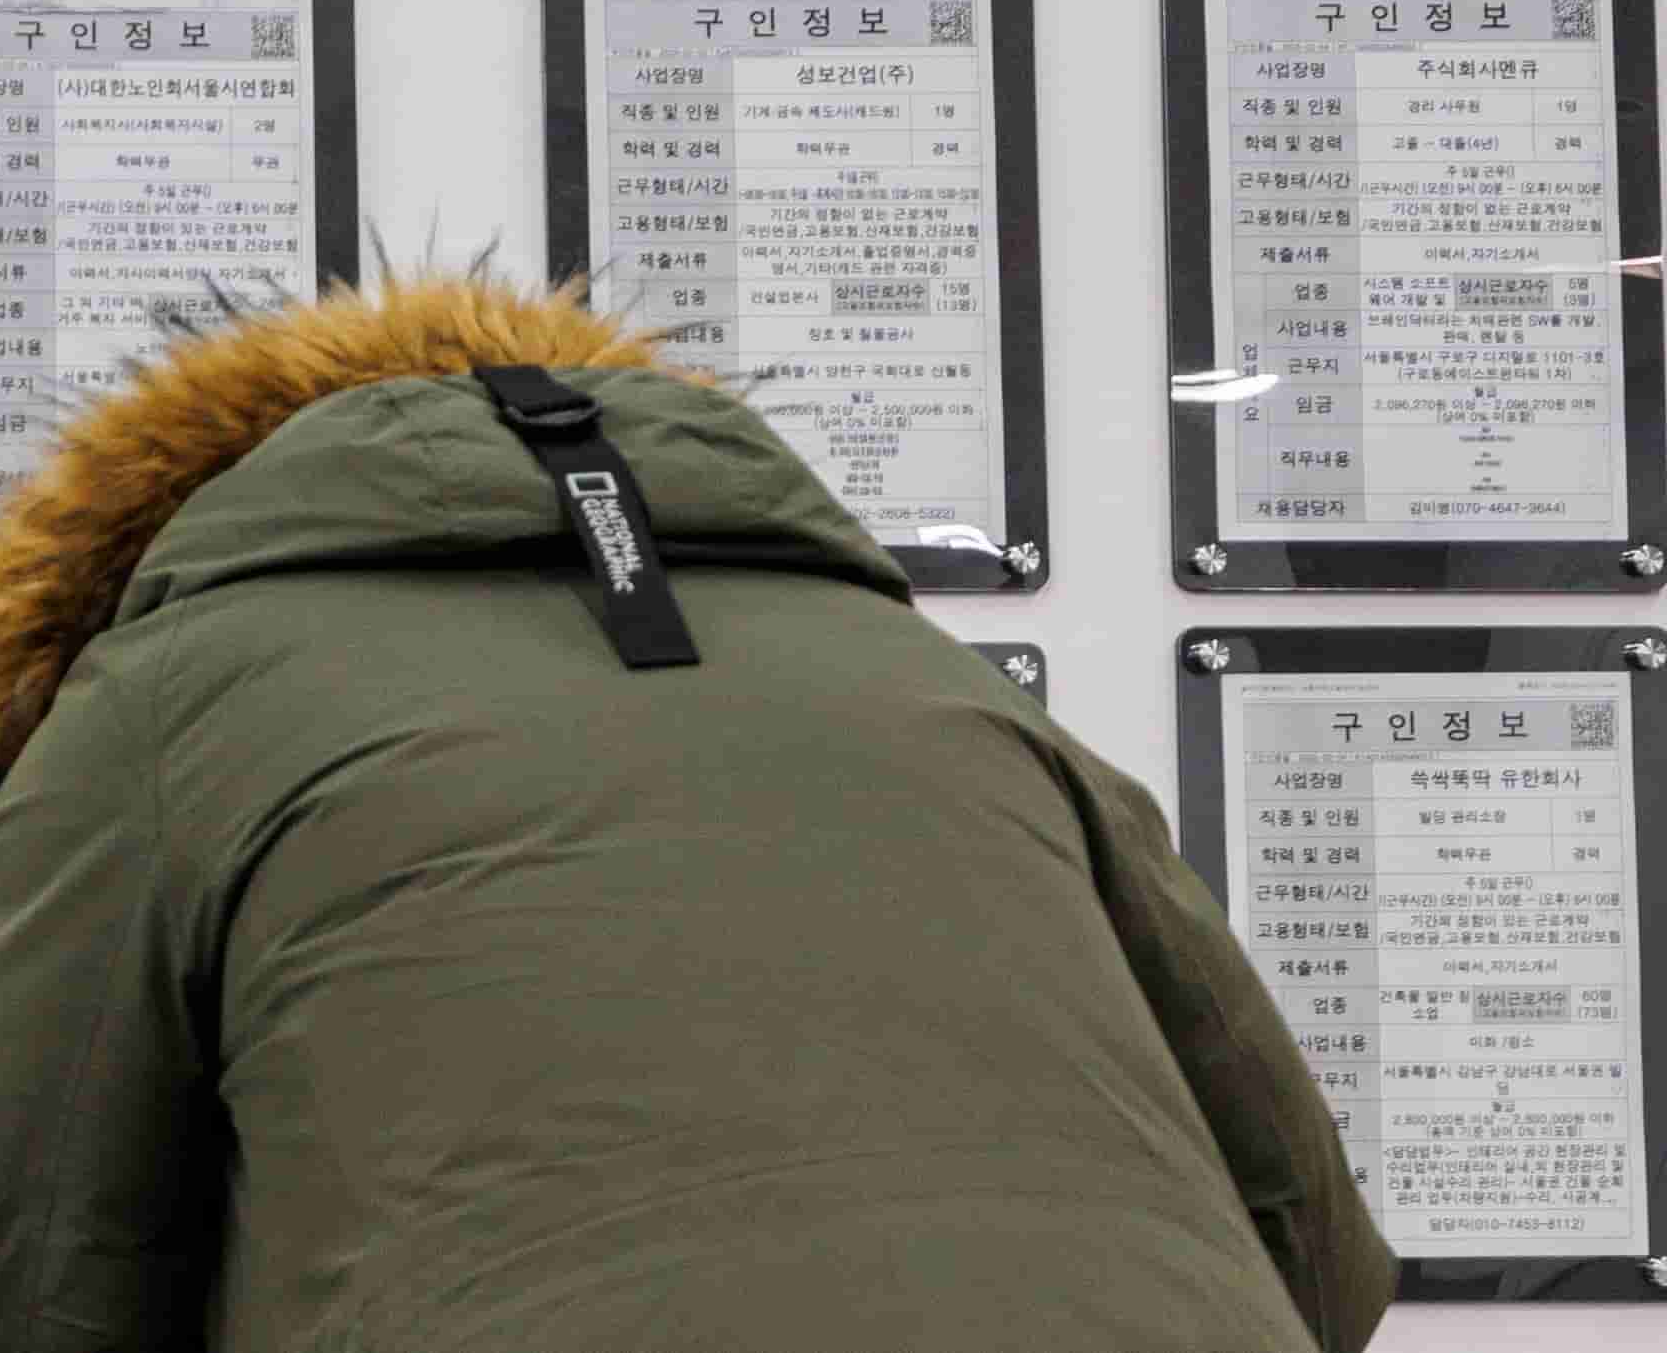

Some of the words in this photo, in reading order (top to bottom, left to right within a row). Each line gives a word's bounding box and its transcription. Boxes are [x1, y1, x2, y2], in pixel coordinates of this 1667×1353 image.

[635, 65, 704, 86] 사업장명
[796, 63, 914, 86] 성보건업(주)
[1256, 62, 1326, 82] 사업장명
[58, 78, 296, 100] (사)대한노인회서울시연합회
[618, 177, 729, 195] 근무형태/시간
[1238, 171, 1351, 192] 근무형태/시간
[616, 214, 728, 234] 고용형태/보험
[1237, 206, 1351, 227] 고용형태/보험
[1274, 771, 1343, 791] 사업장명
[1500, 766, 1582, 789] 유한회사
[1255, 883, 1370, 904] 근무형태/시간
[1256, 921, 1370, 941] 고용형태/보험
